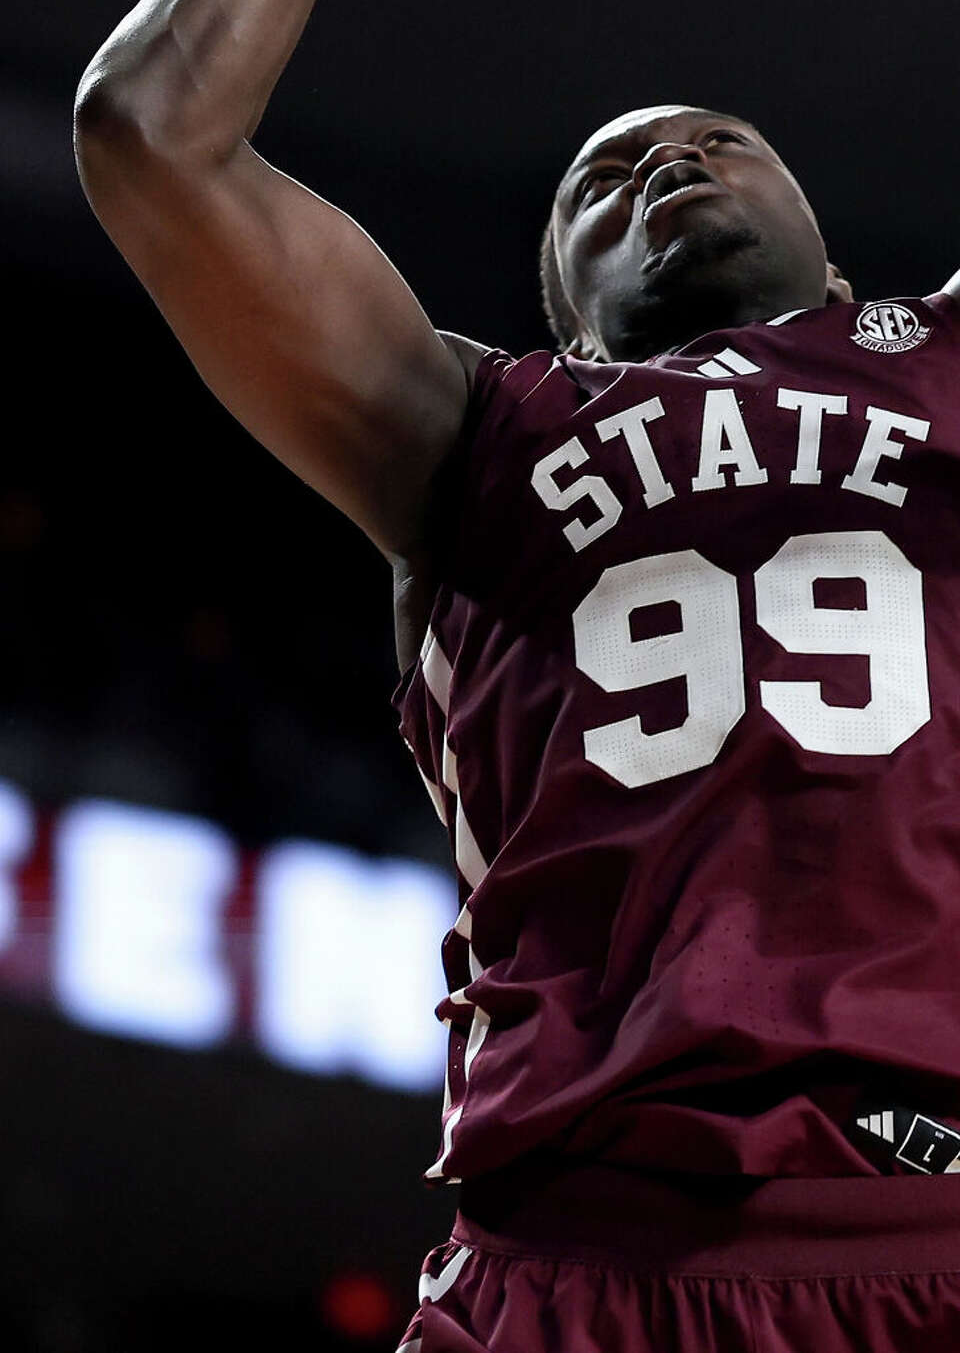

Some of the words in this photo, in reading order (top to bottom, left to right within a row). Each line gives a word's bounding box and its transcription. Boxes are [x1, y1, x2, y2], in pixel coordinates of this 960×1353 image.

[861, 306, 914, 342] SEC
[530, 388, 932, 554] STATE
[571, 529, 933, 790] 99
[922, 1143, 935, 1162] L
